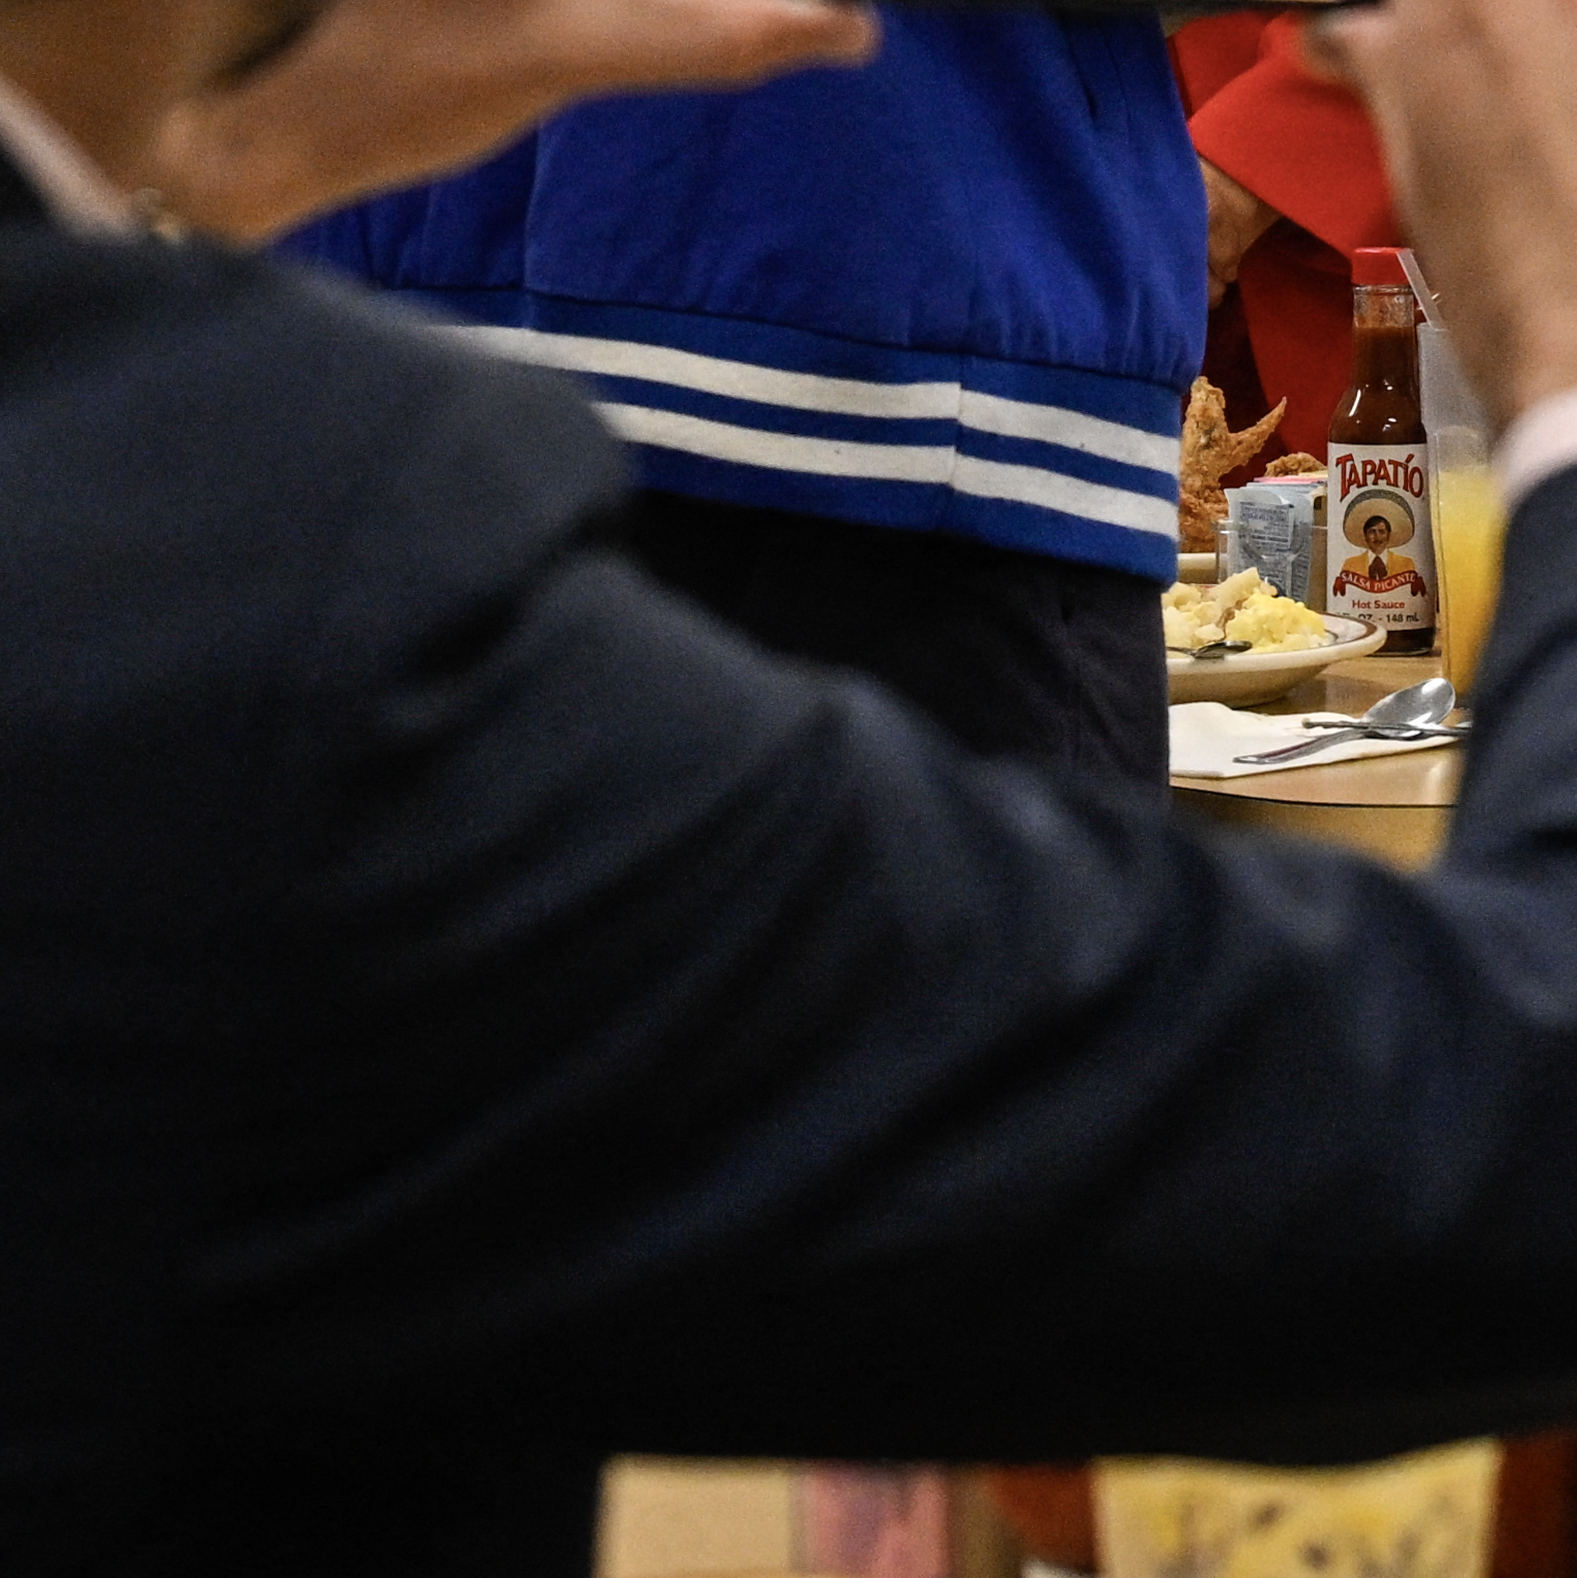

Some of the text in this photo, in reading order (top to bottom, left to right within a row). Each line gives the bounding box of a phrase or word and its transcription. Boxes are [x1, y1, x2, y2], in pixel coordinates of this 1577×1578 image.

[1335, 453, 1425, 503] TAPATÍO
[1340, 570, 1417, 592] SALSA PICANTE
[1352, 599, 1405, 609] Hot Sauce
[1386, 613, 1404, 623] 148
[1405, 612, 1420, 623] mL
